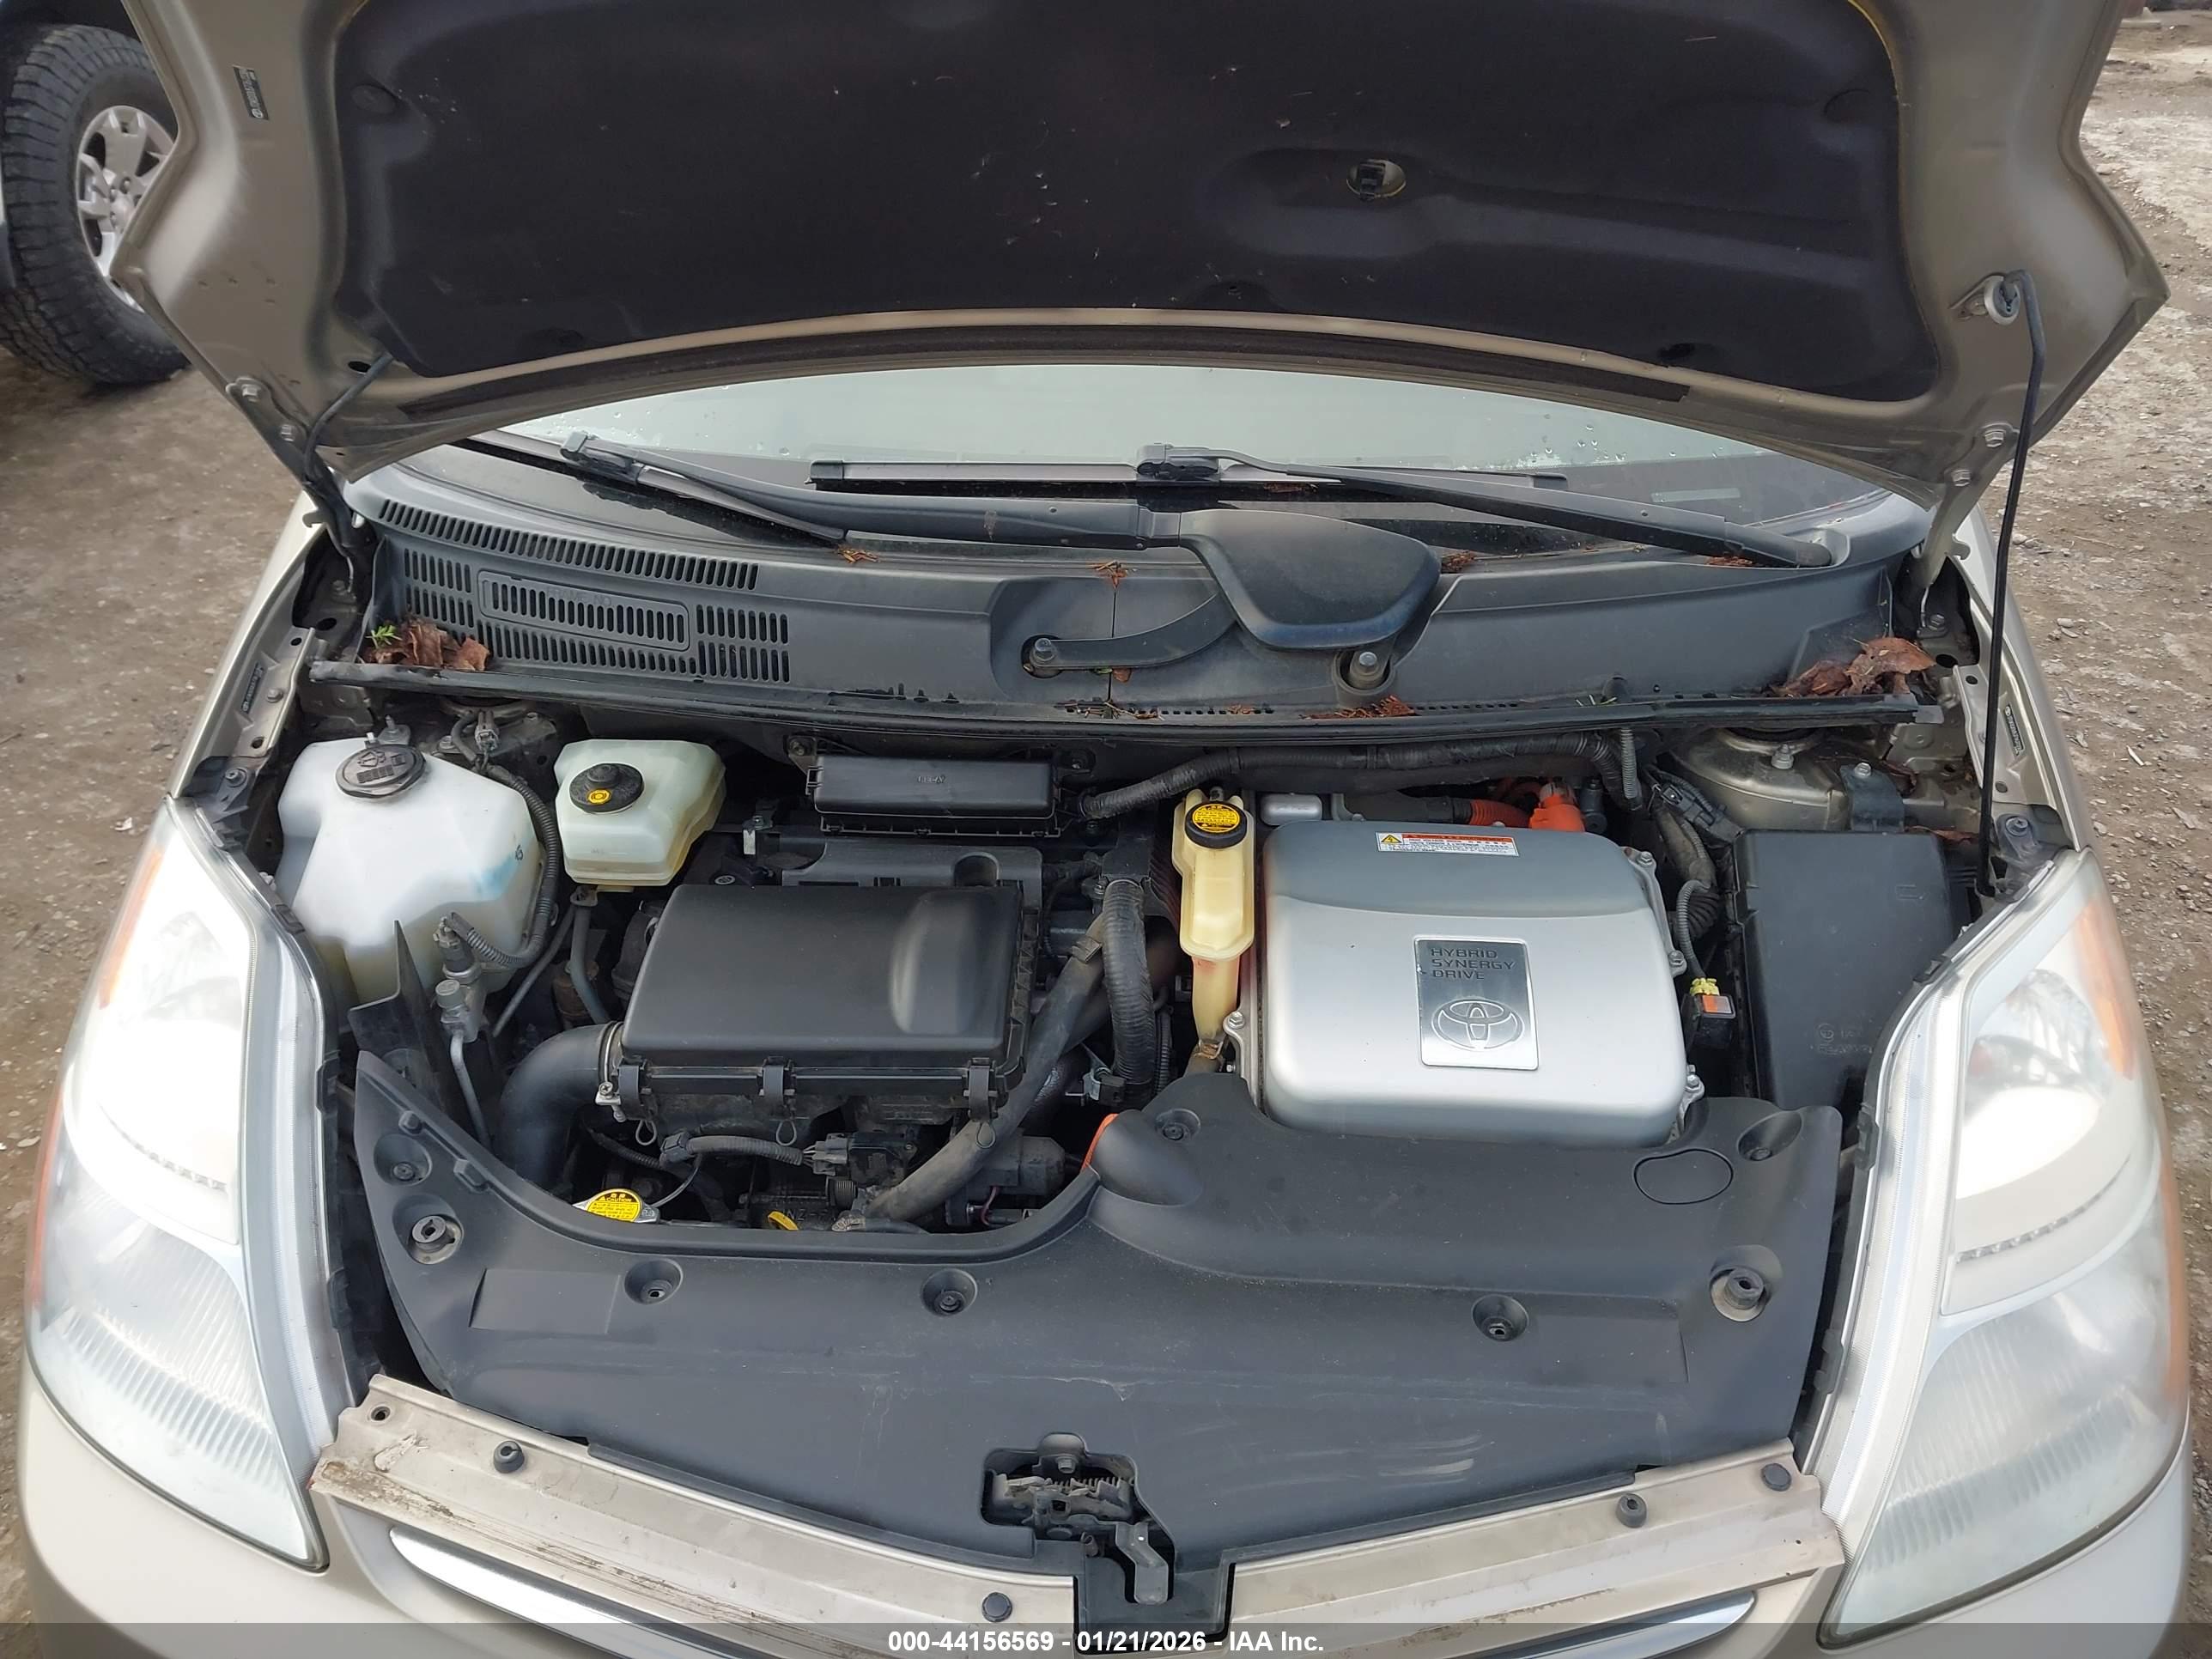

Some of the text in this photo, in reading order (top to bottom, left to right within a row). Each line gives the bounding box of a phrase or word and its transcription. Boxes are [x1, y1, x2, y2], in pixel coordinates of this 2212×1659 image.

[1431, 948, 1498, 958] HYBRID
[1431, 958, 1516, 969] SYNERGY
[1433, 969, 1485, 980] DRIVE
